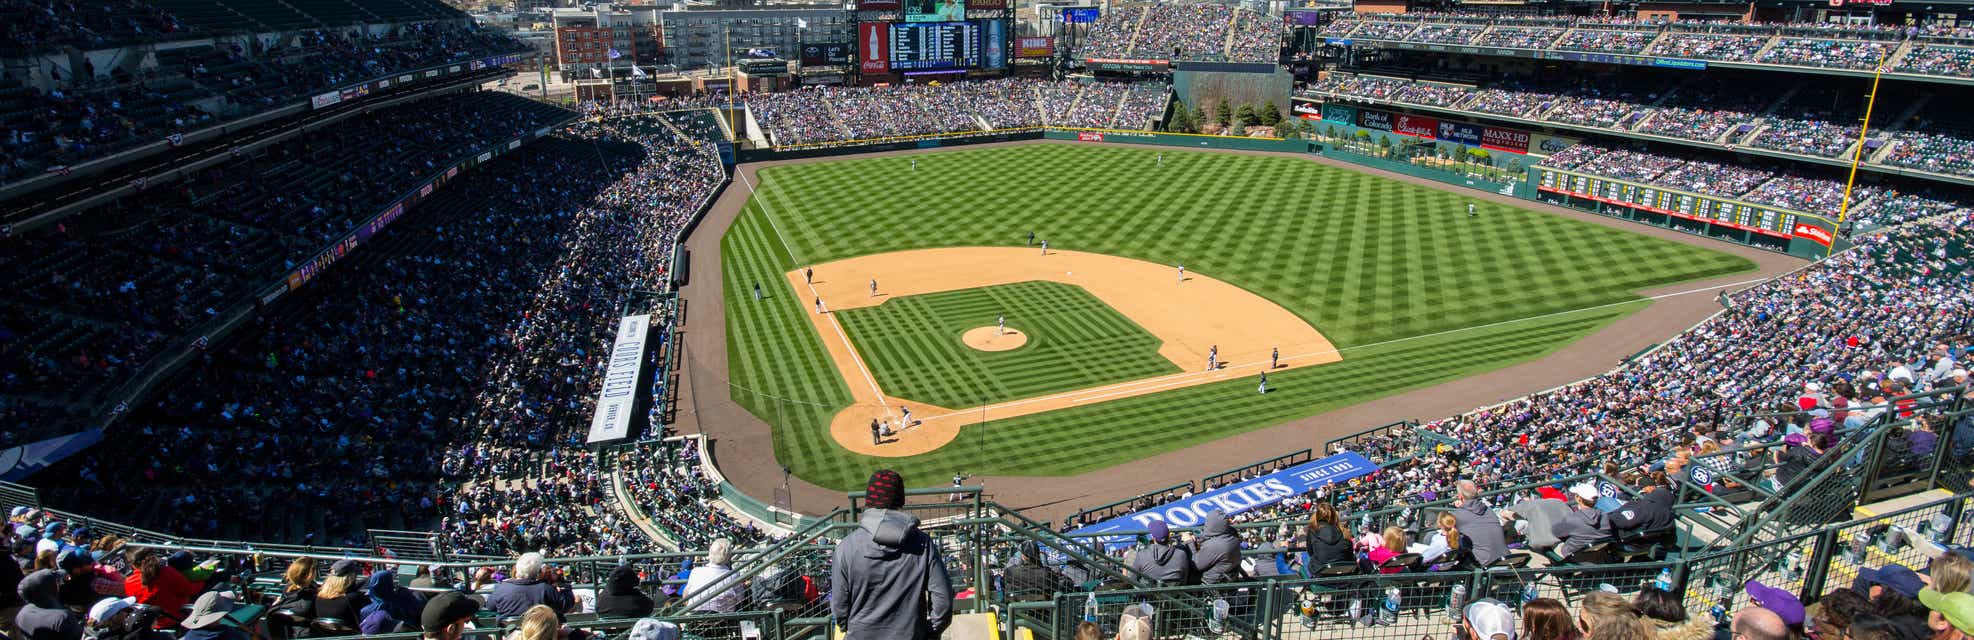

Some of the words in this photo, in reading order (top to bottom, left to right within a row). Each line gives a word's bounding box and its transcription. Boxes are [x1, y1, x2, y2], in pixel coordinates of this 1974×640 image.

[1022, 39, 1048, 48] KING
[1365, 111, 1380, 121] Bank
[1380, 113, 1389, 122] of
[1364, 120, 1393, 130] Colorado
[1484, 129, 1512, 141] MAXX
[1513, 133, 1529, 143] HD
[612, 341, 641, 368] COORS
[604, 370, 634, 398] FIELD
[1300, 469, 1330, 481] SINCE
[1693, 472, 1708, 483] 326
[1601, 485, 1614, 498] 327
[1132, 477, 1295, 529] ROCKIES
